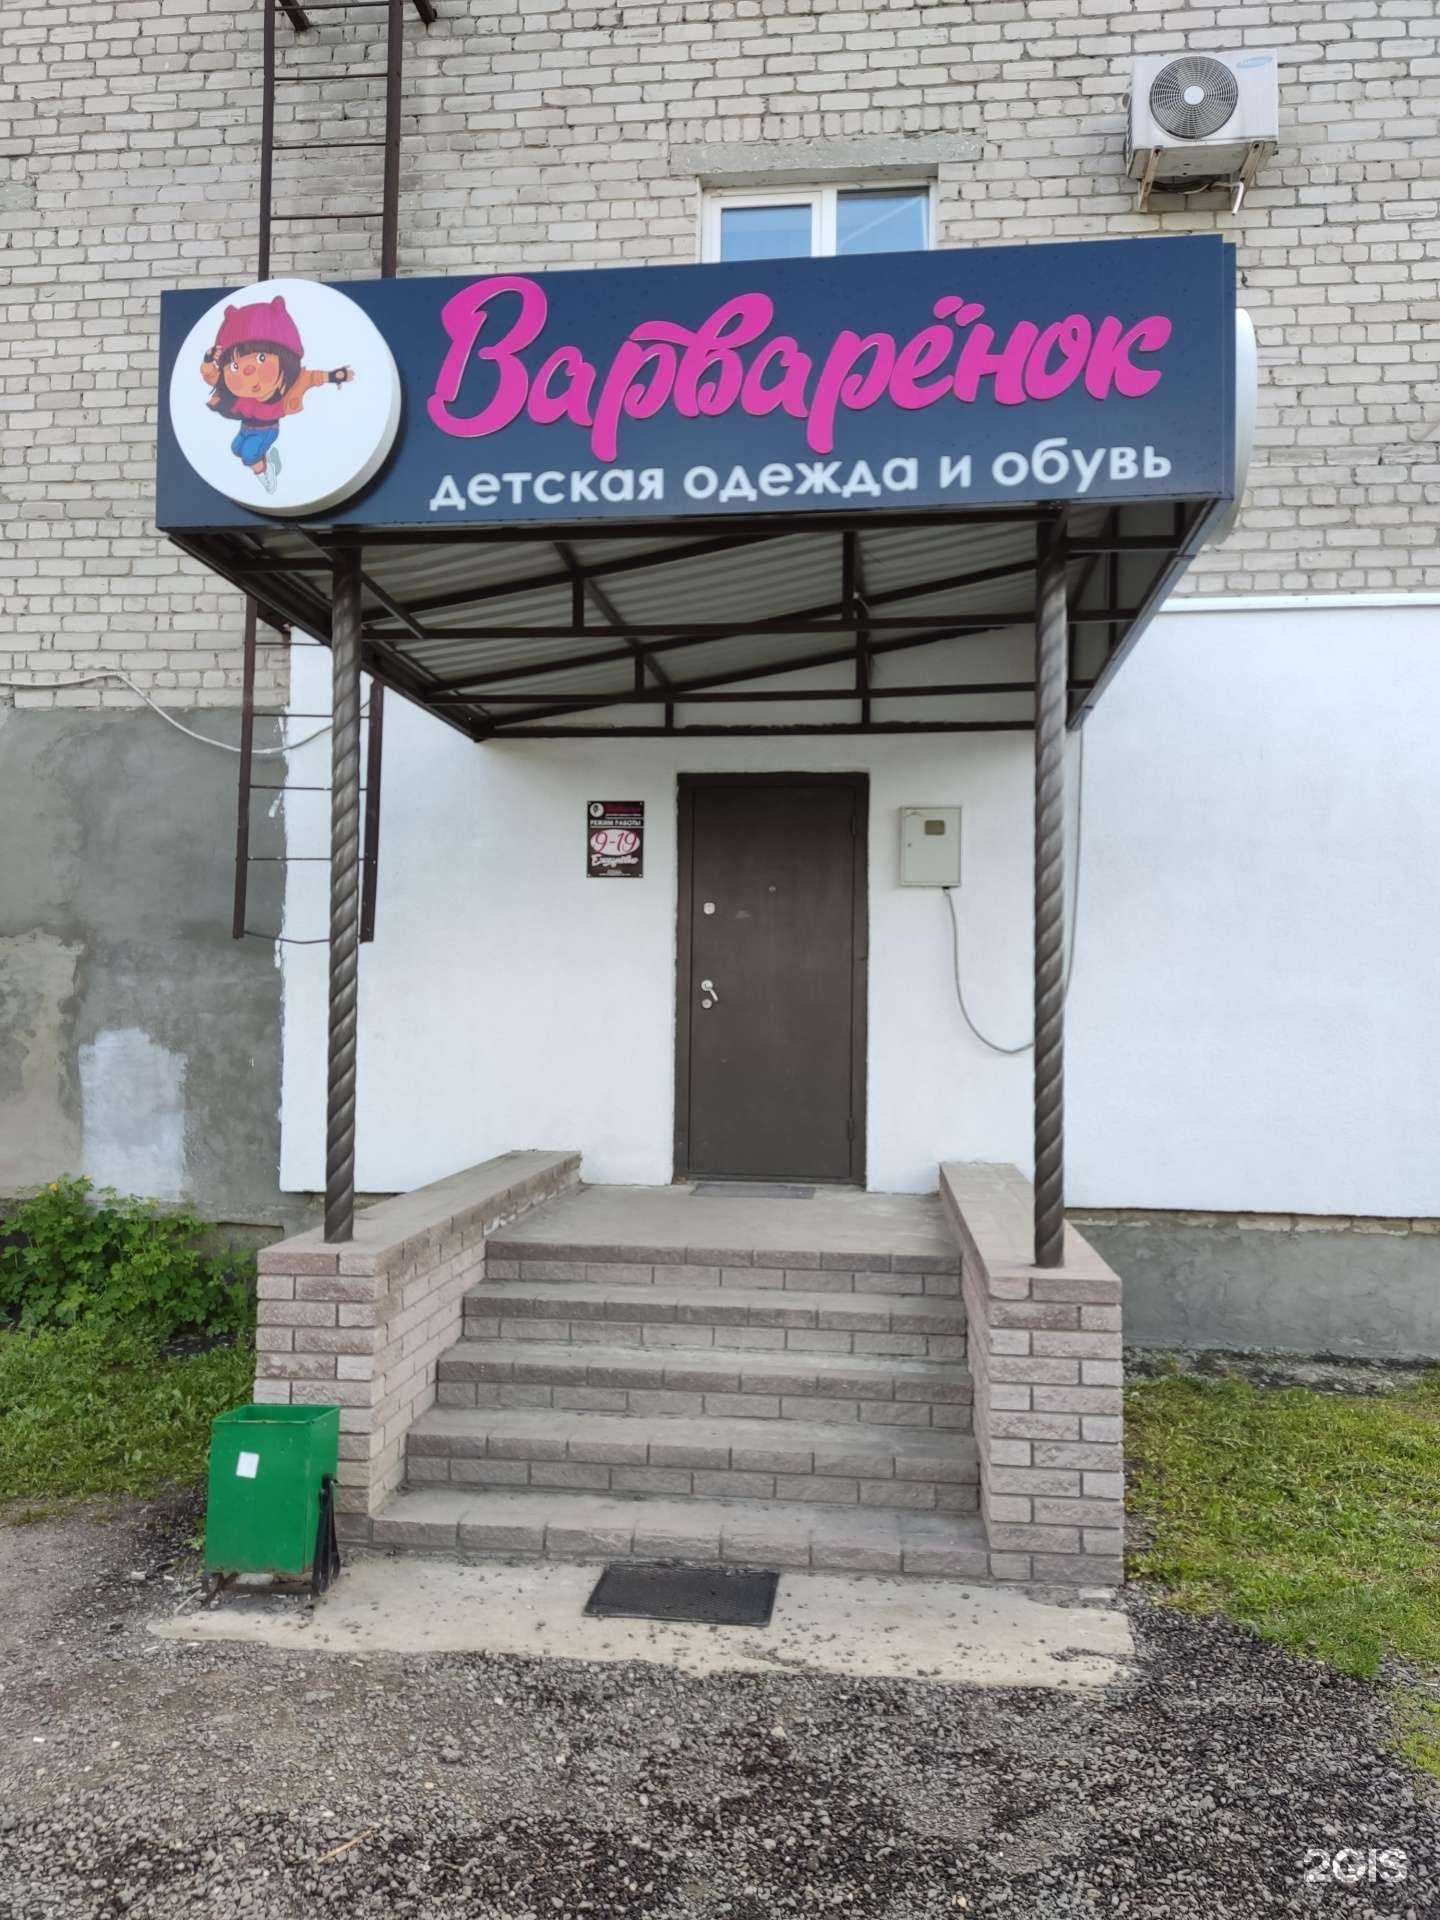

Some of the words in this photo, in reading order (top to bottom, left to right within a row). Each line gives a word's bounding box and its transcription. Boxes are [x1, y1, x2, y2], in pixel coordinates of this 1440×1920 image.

[427, 275, 1172, 463] Варварёнок
[429, 468, 665, 512] детская
[683, 460, 919, 505] одежда
[939, 456, 972, 489] и
[991, 437, 1172, 494] обувь
